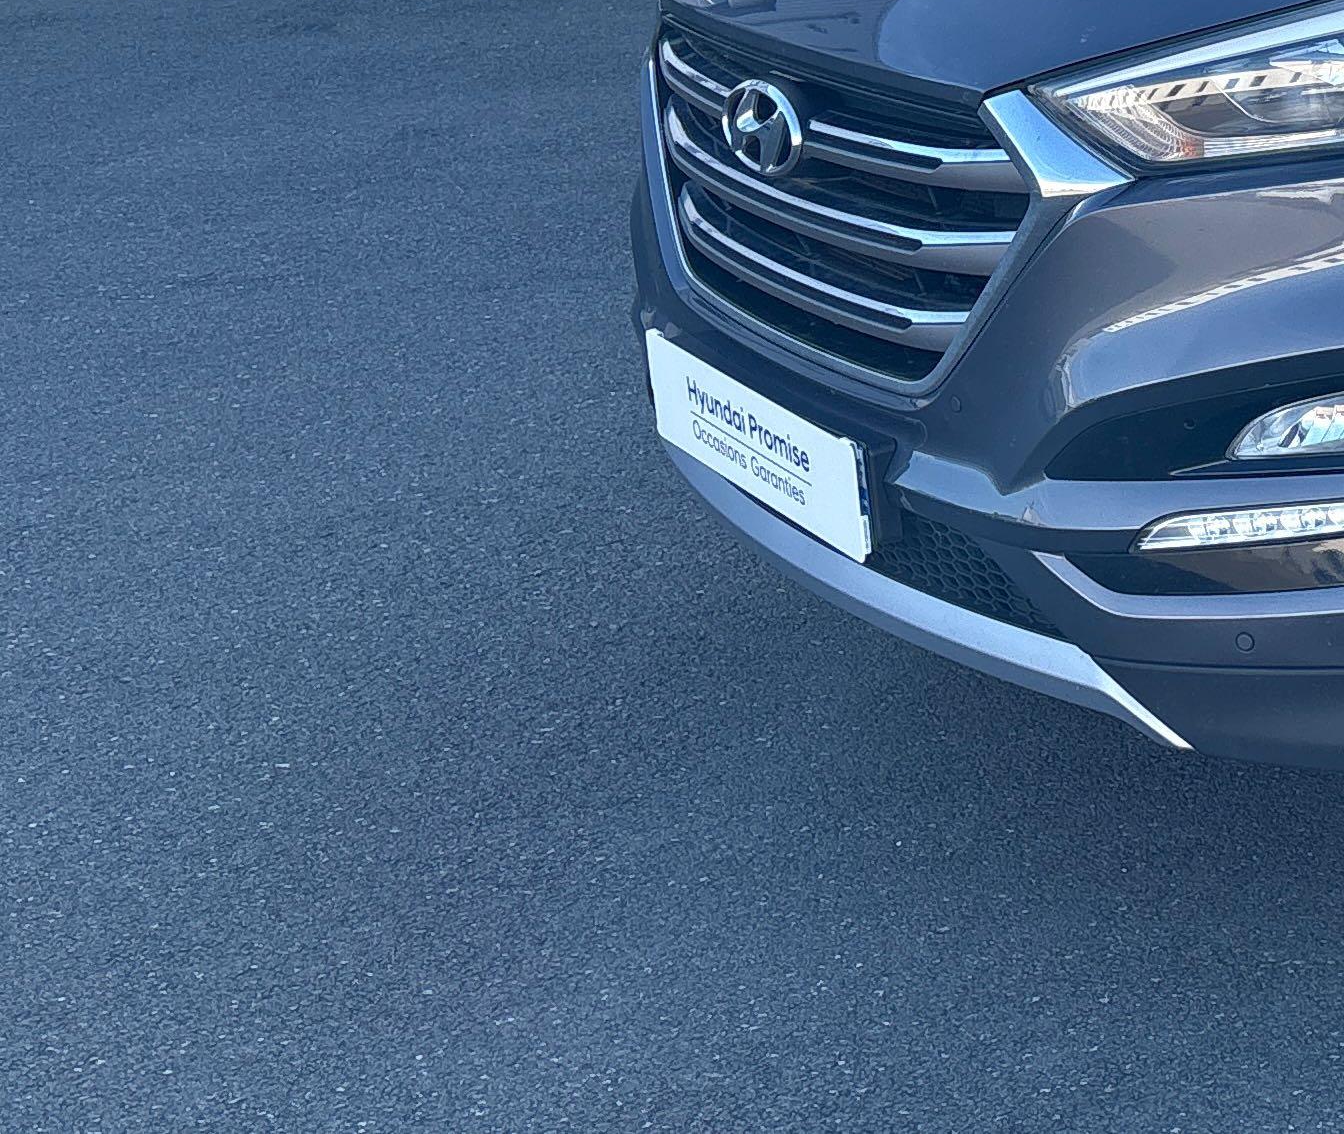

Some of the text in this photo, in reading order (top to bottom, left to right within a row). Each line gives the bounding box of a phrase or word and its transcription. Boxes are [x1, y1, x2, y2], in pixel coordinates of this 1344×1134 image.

[686, 376, 810, 472] Hyundai Promise
[692, 419, 806, 506] Occasions Garanties
